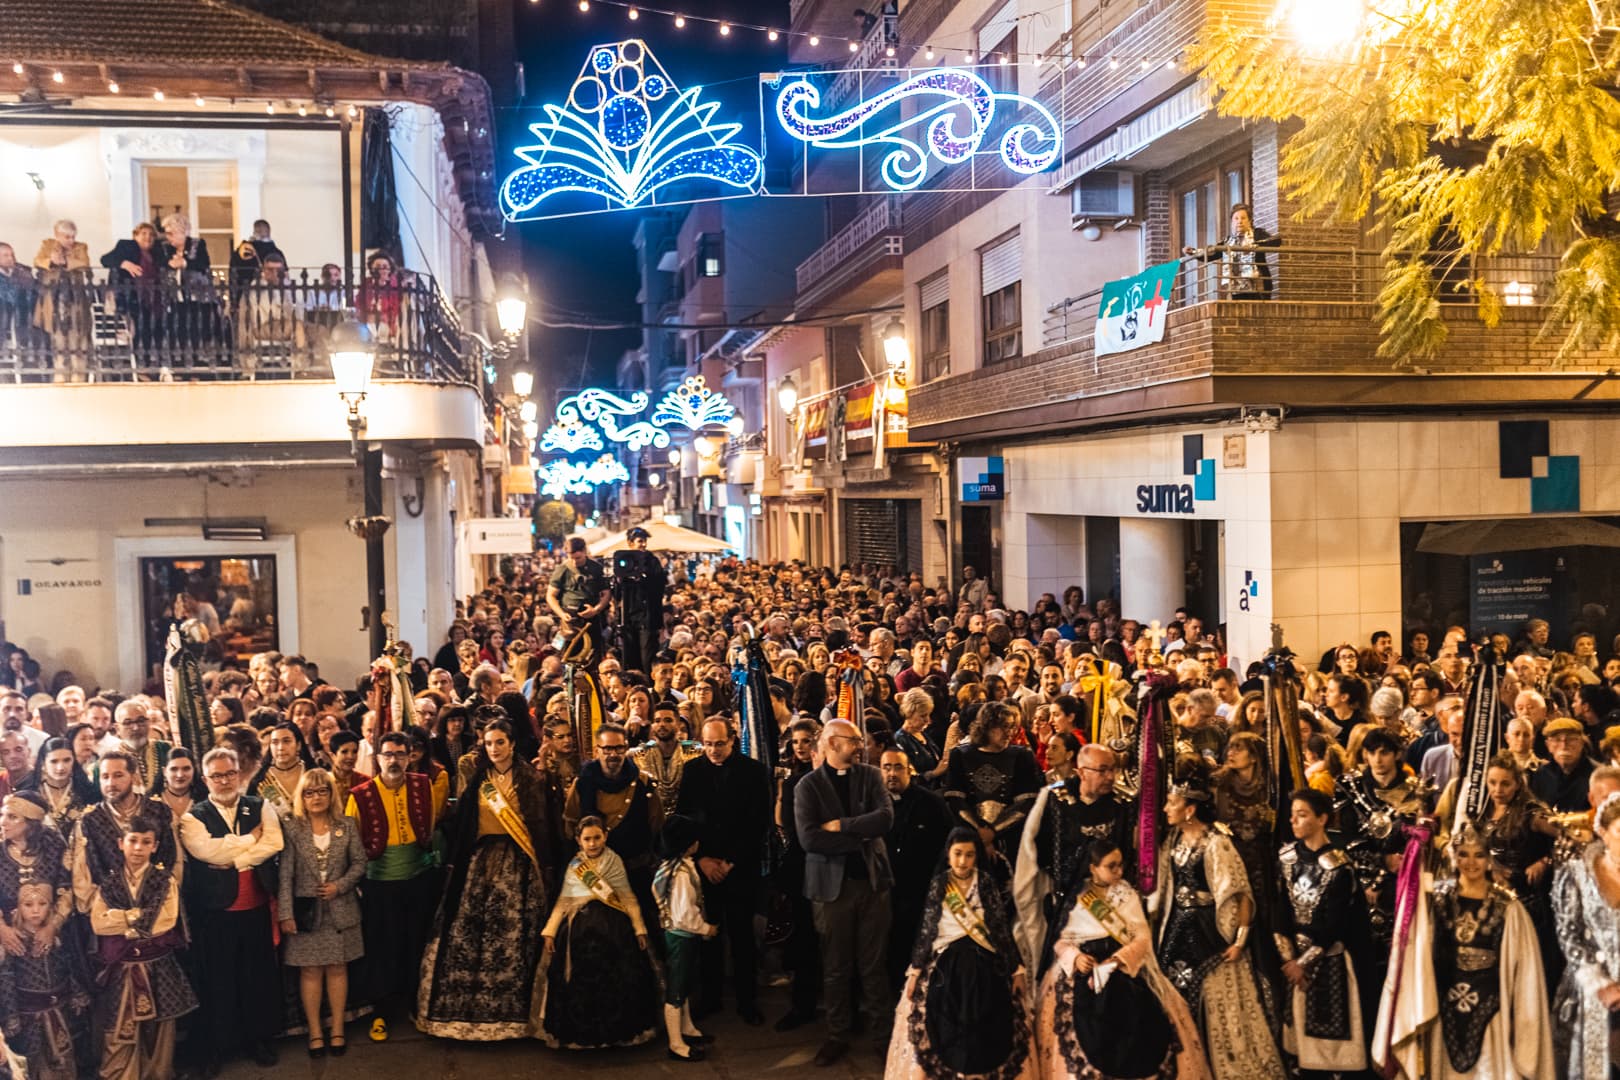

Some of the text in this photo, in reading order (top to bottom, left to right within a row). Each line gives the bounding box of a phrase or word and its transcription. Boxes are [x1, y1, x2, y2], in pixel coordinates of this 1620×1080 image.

[970, 484, 996, 493] suma
[1136, 484, 1195, 514] suma
[1239, 588, 1250, 612] a
